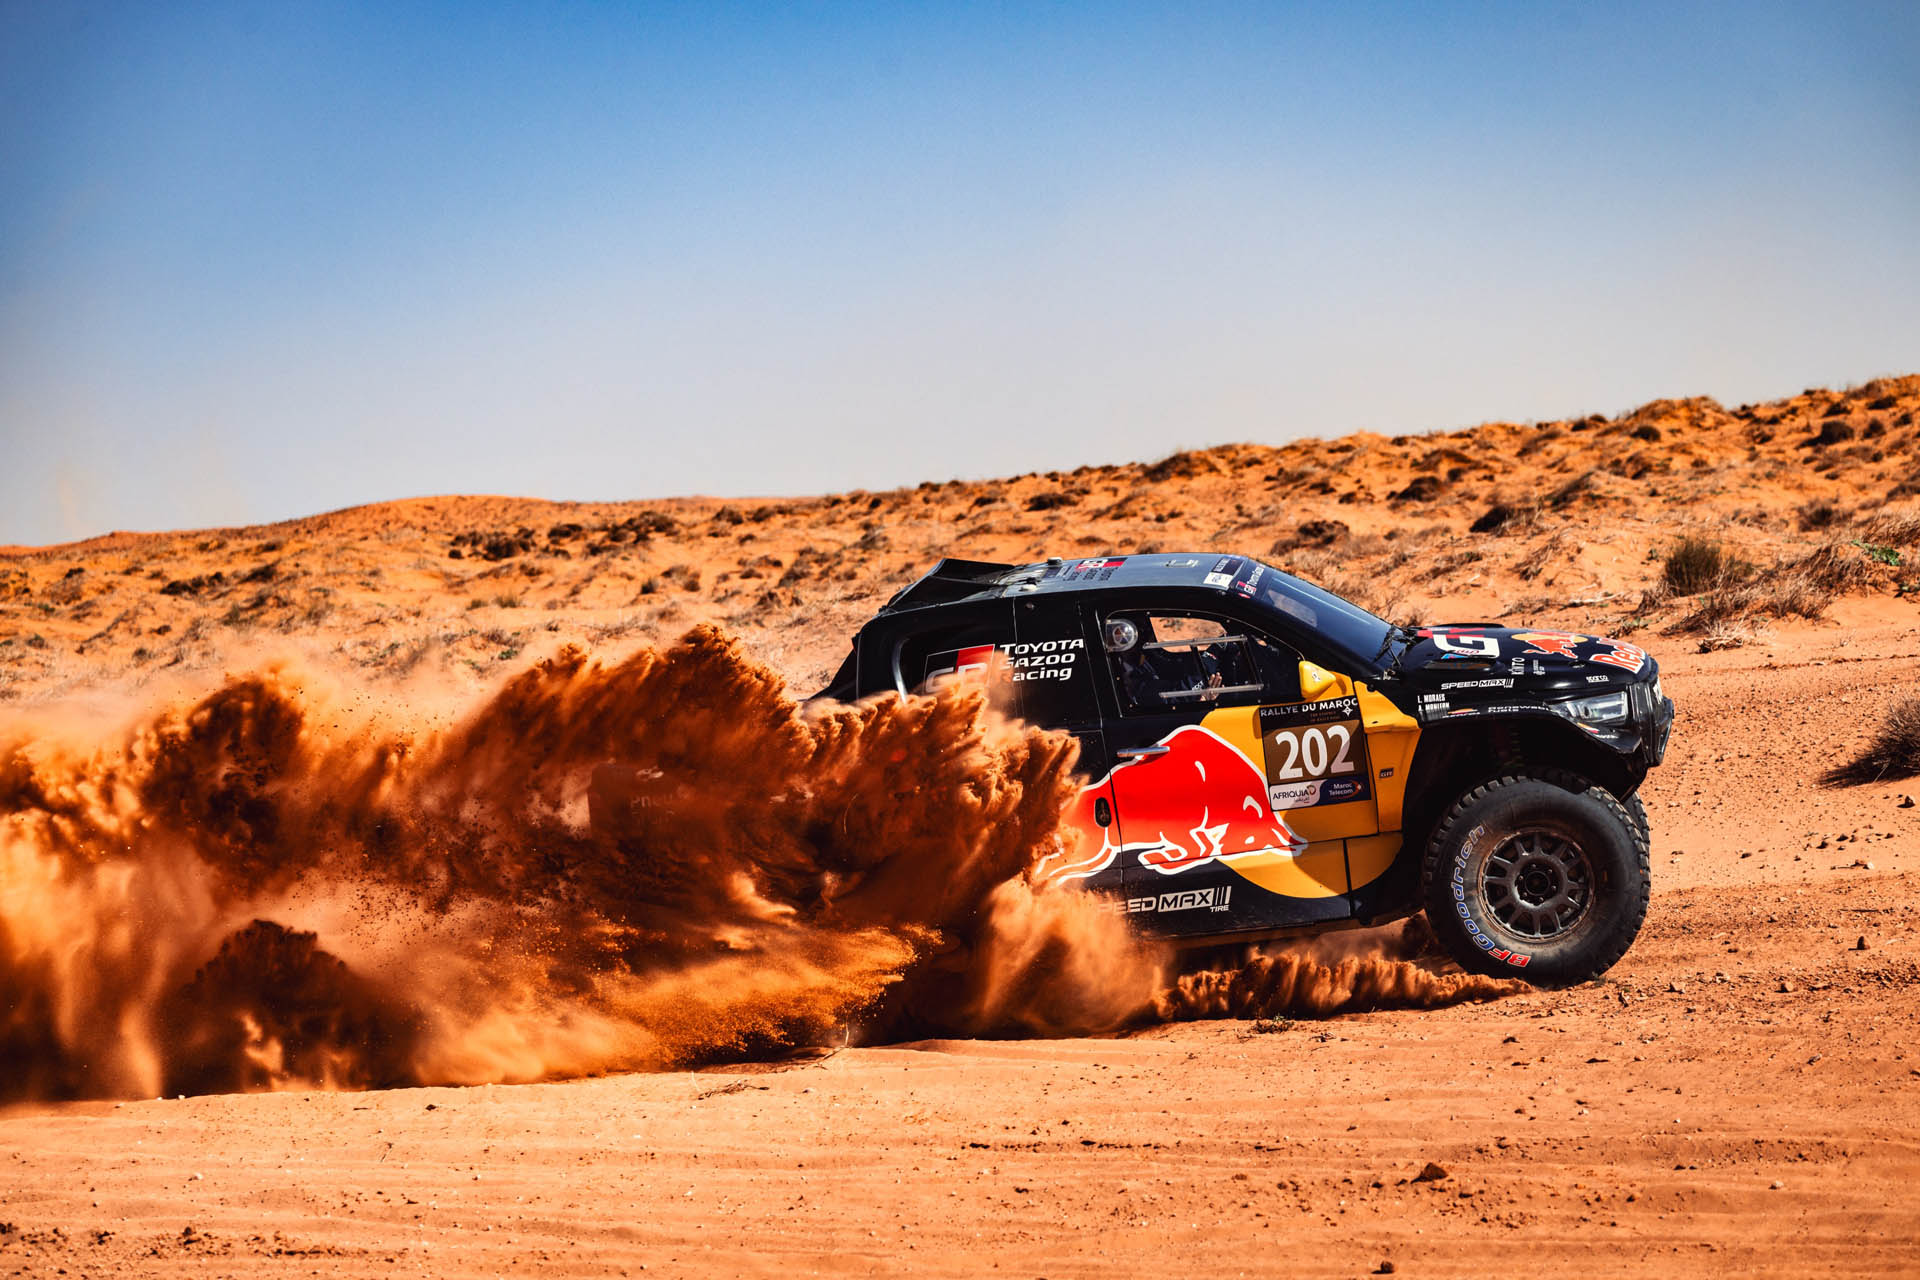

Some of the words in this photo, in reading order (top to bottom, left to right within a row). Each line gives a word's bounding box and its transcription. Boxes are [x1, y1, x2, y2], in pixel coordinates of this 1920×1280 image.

[1000, 638, 1084, 655] TOYOTA
[1003, 667, 1073, 681] acing
[1260, 705, 1299, 717] RALLYE
[1302, 703, 1317, 712] DU
[1319, 697, 1359, 710] MAROC
[1275, 724, 1355, 780] 202
[1328, 787, 1354, 796] Telecom
[1333, 782, 1352, 790] Maroc
[1272, 788, 1310, 800] AFRIQUIA
[1209, 904, 1230, 913] TIRE
